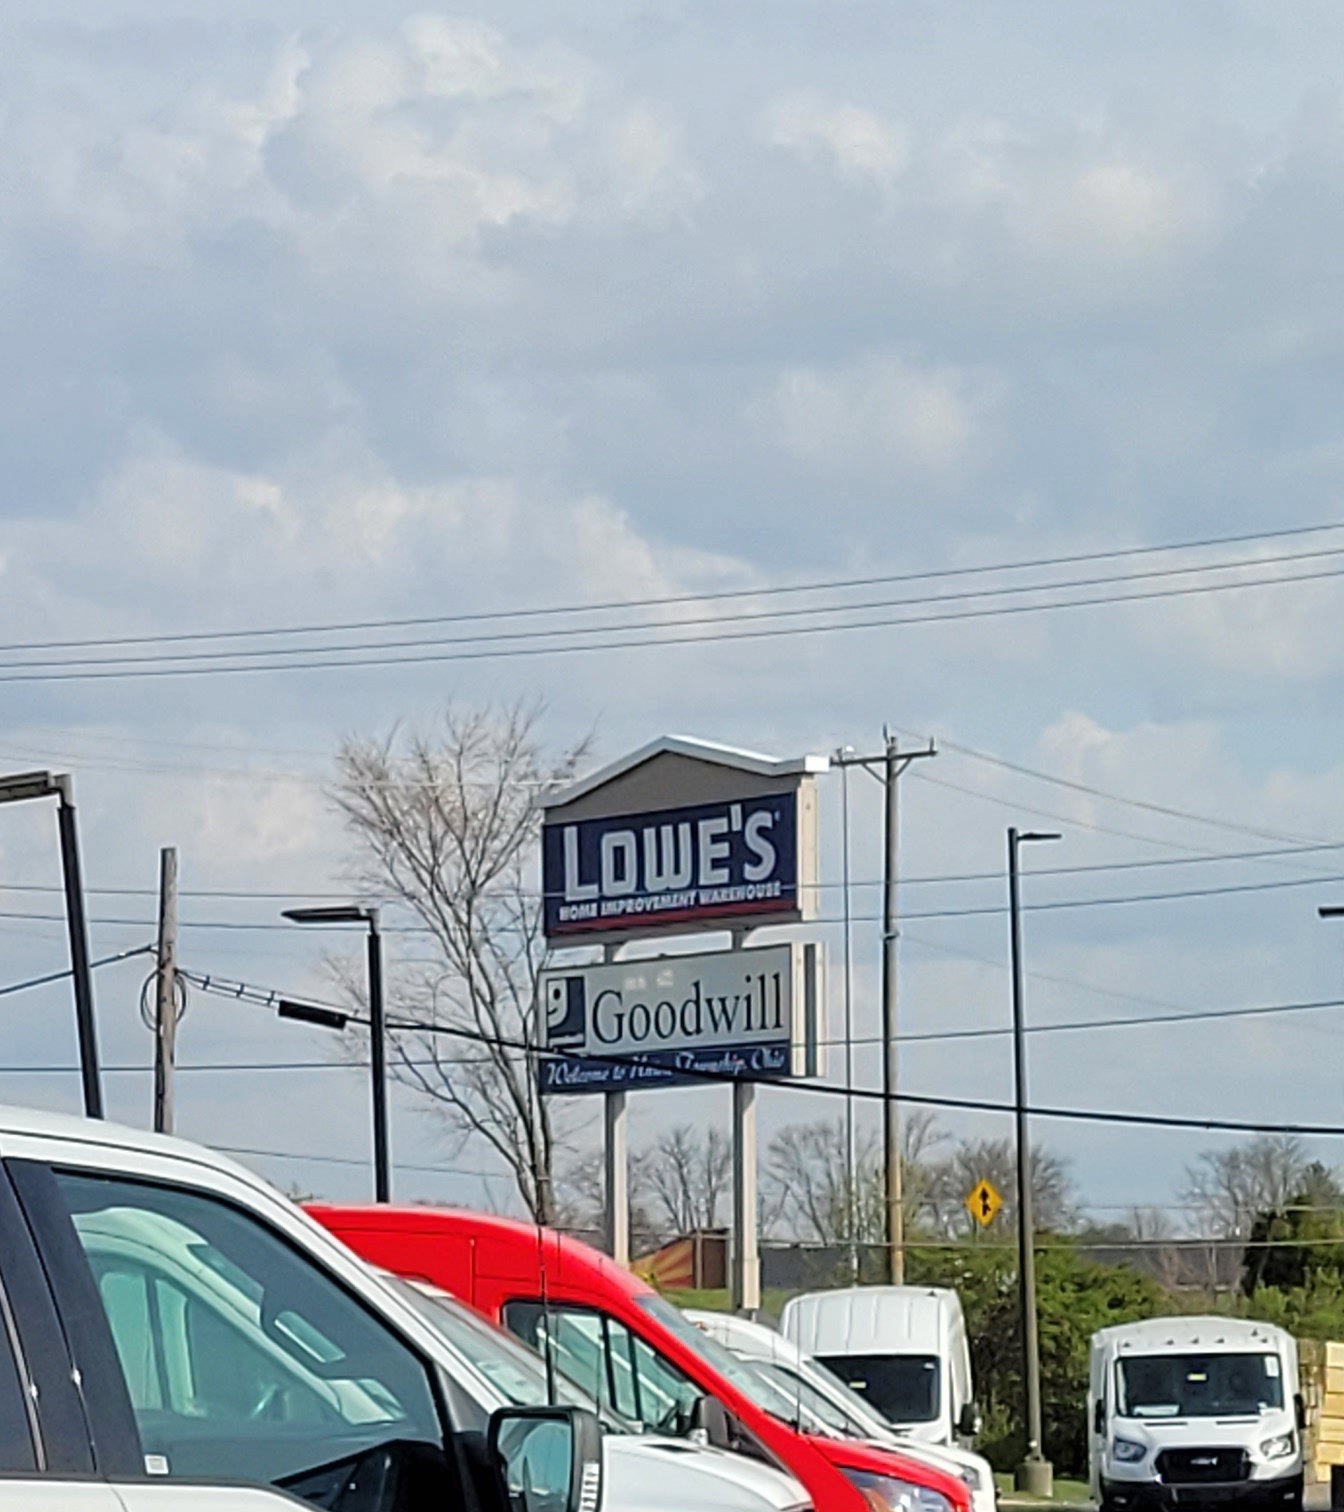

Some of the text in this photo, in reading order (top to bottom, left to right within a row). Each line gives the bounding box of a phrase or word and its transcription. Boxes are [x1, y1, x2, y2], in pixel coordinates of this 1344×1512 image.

[563, 803, 777, 902] LOWE'S
[559, 880, 781, 922] HOME IMPROVEMENT WAREHOUSE
[592, 972, 784, 1044] Goodwill
